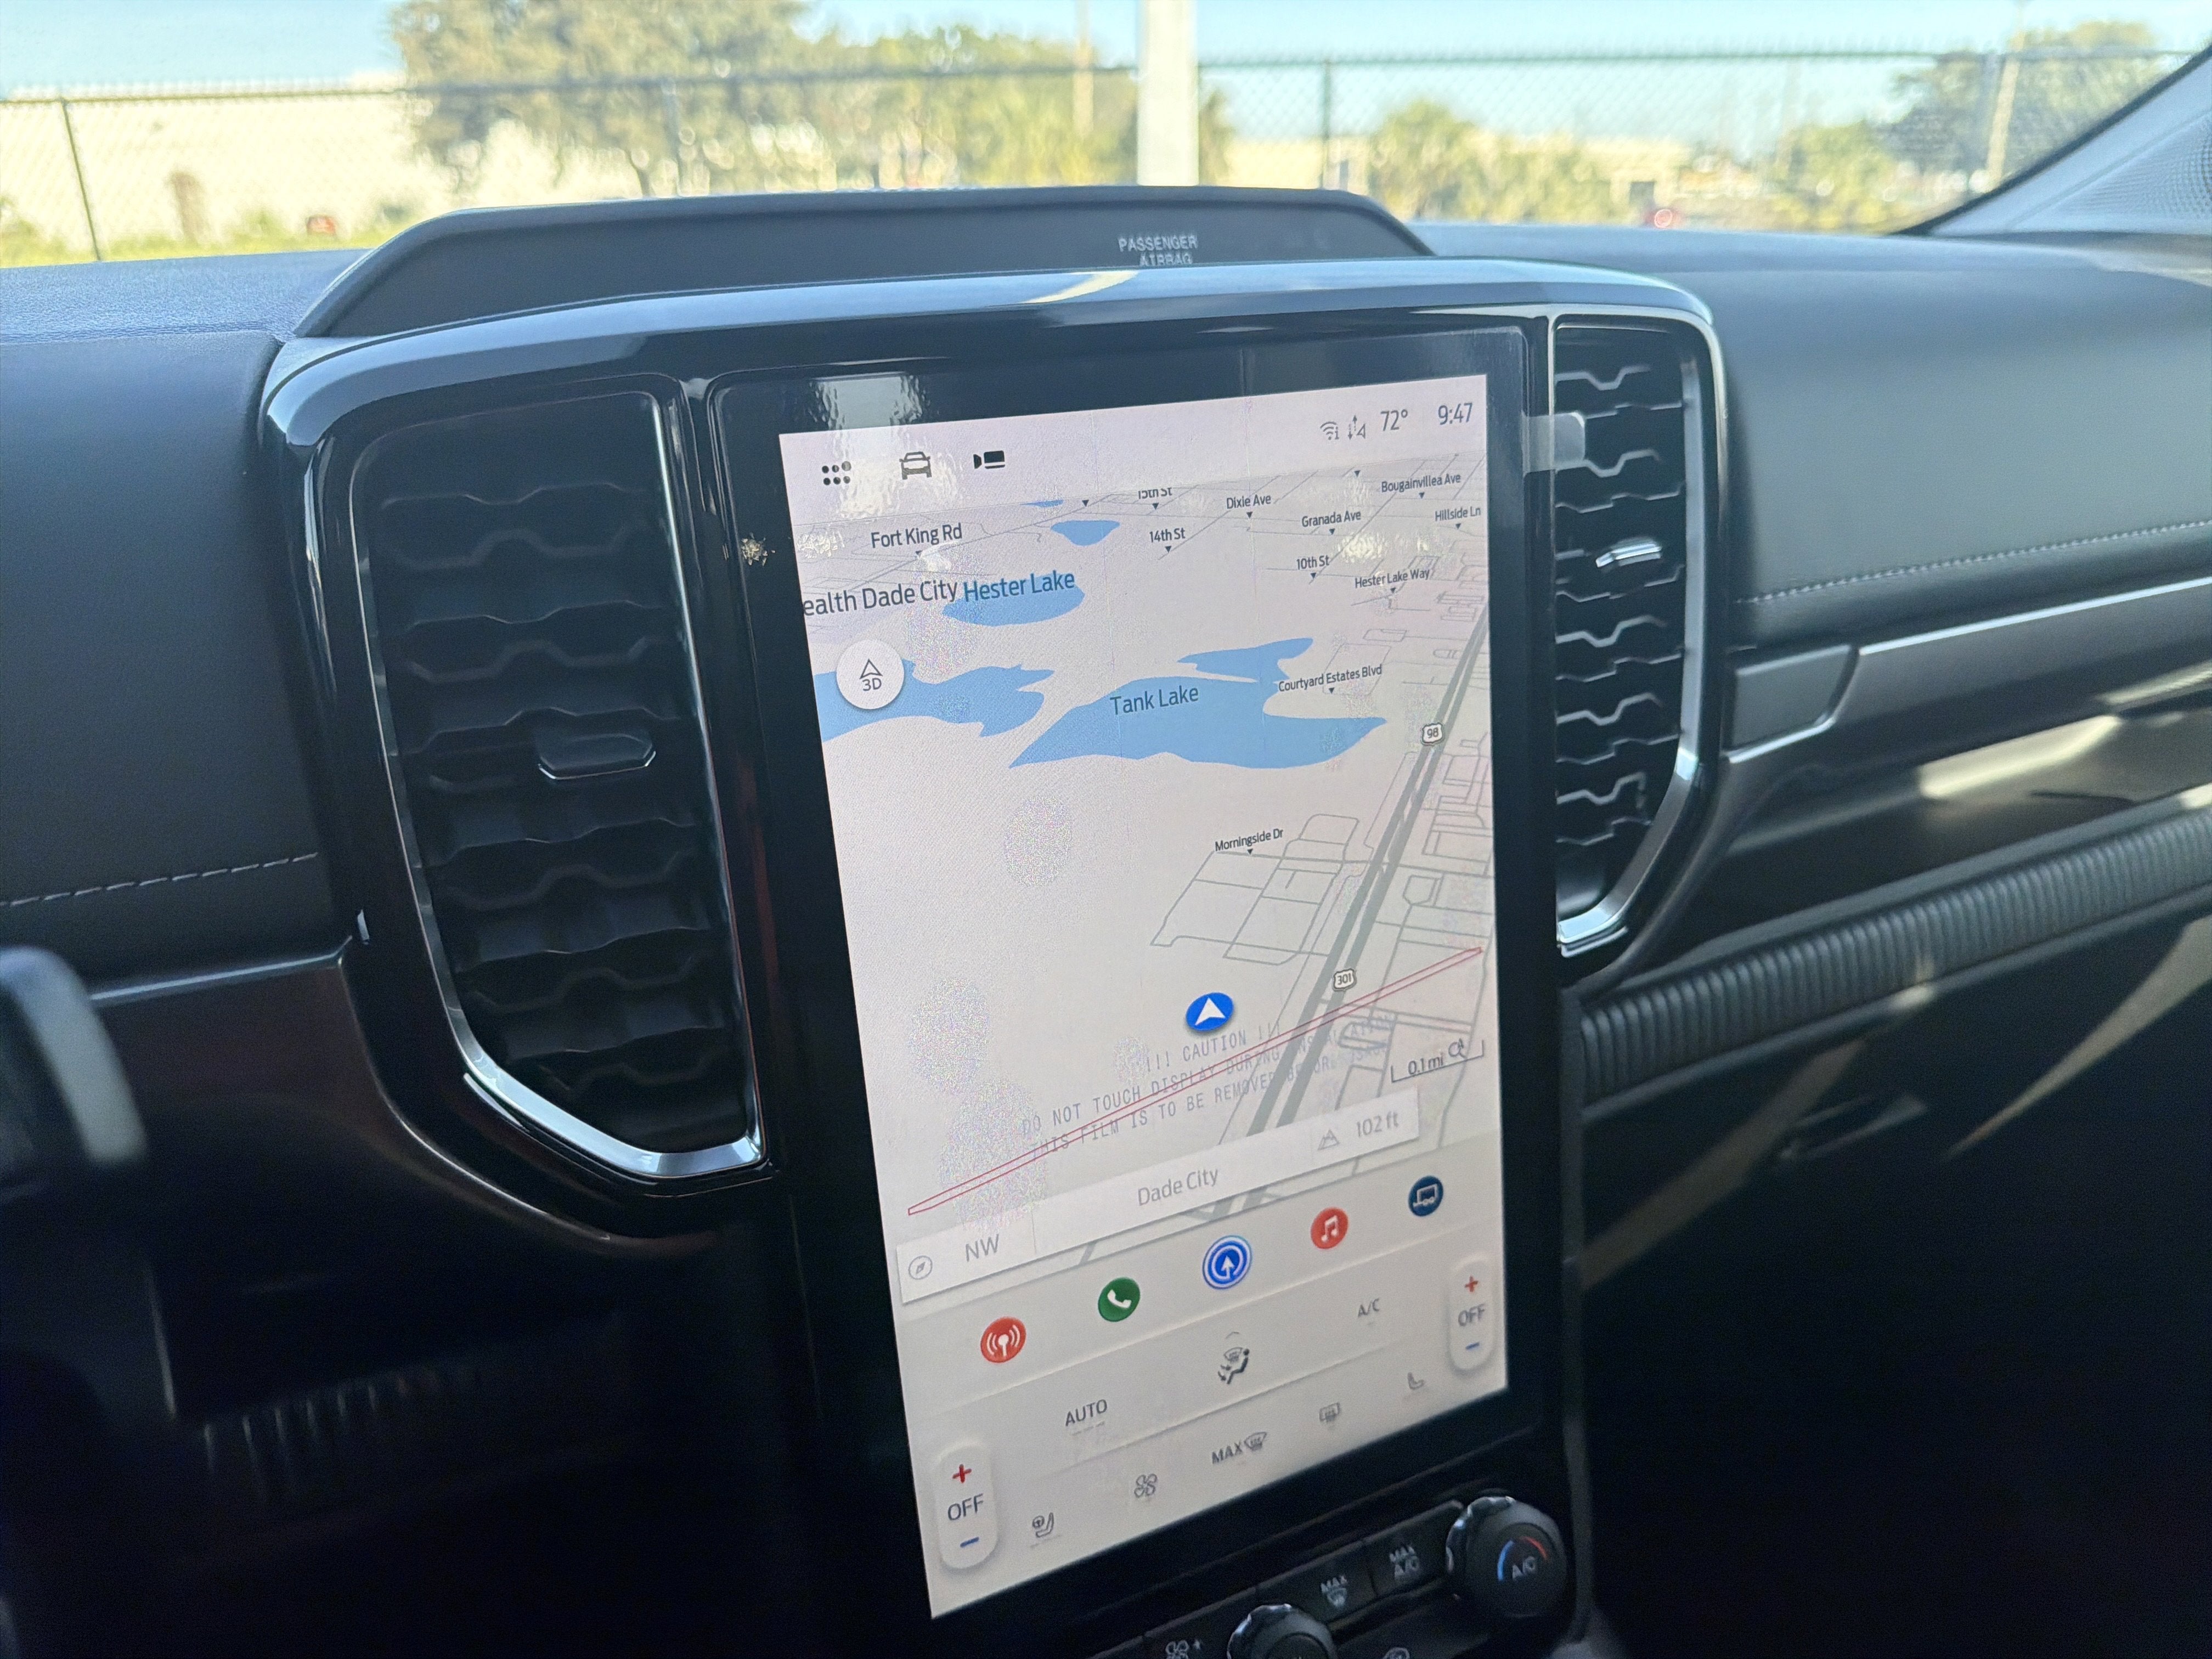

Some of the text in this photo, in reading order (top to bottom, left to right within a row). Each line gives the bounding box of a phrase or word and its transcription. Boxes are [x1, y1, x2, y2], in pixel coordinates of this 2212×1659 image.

[1118, 235, 1198, 252] PASSENGER
[1438, 402, 1473, 425] 9:47
[1381, 472, 1462, 493] Bougainvillea Ave
[1226, 494, 1271, 510] Dixie Ave
[1435, 506, 1481, 522] Hillside Ln
[1301, 510, 1362, 528] Granada Ave
[871, 523, 962, 548] Fort King Rd
[1149, 527, 1186, 543] 14th St
[1296, 555, 1329, 571] 10th St
[963, 570, 1075, 602] Hester Lake
[1355, 568, 1429, 588] Hester Lake Way
[803, 580, 958, 616] ealth Dade City
[862, 678, 882, 691] 3D
[1278, 664, 1383, 692] Courtyard Estates Blvd
[1110, 685, 1199, 715] Tank Lake
[1427, 727, 1439, 738] 98
[1215, 828, 1284, 852] Morningside Dr
[1337, 972, 1351, 985] 301
[1183, 1029, 1246, 1062] CAUTION
[1408, 1052, 1444, 1075] 0.1 mi
[1052, 1102, 1081, 1128] NOT
[1093, 1085, 1141, 1114] TOUCH
[1131, 1109, 1148, 1129] IS
[1159, 1101, 1177, 1120] TO
[1187, 1092, 1204, 1112] BE
[1355, 1109, 1399, 1139] 102 ft
[1137, 1166, 1219, 1206] Dade City
[964, 1233, 1000, 1262] NW
[1357, 1298, 1380, 1318] A/C
[1457, 1304, 1486, 1328] OFF
[1065, 1398, 1108, 1427] AUTO
[1211, 1441, 1243, 1465] MAX
[947, 1492, 985, 1522] OFF
